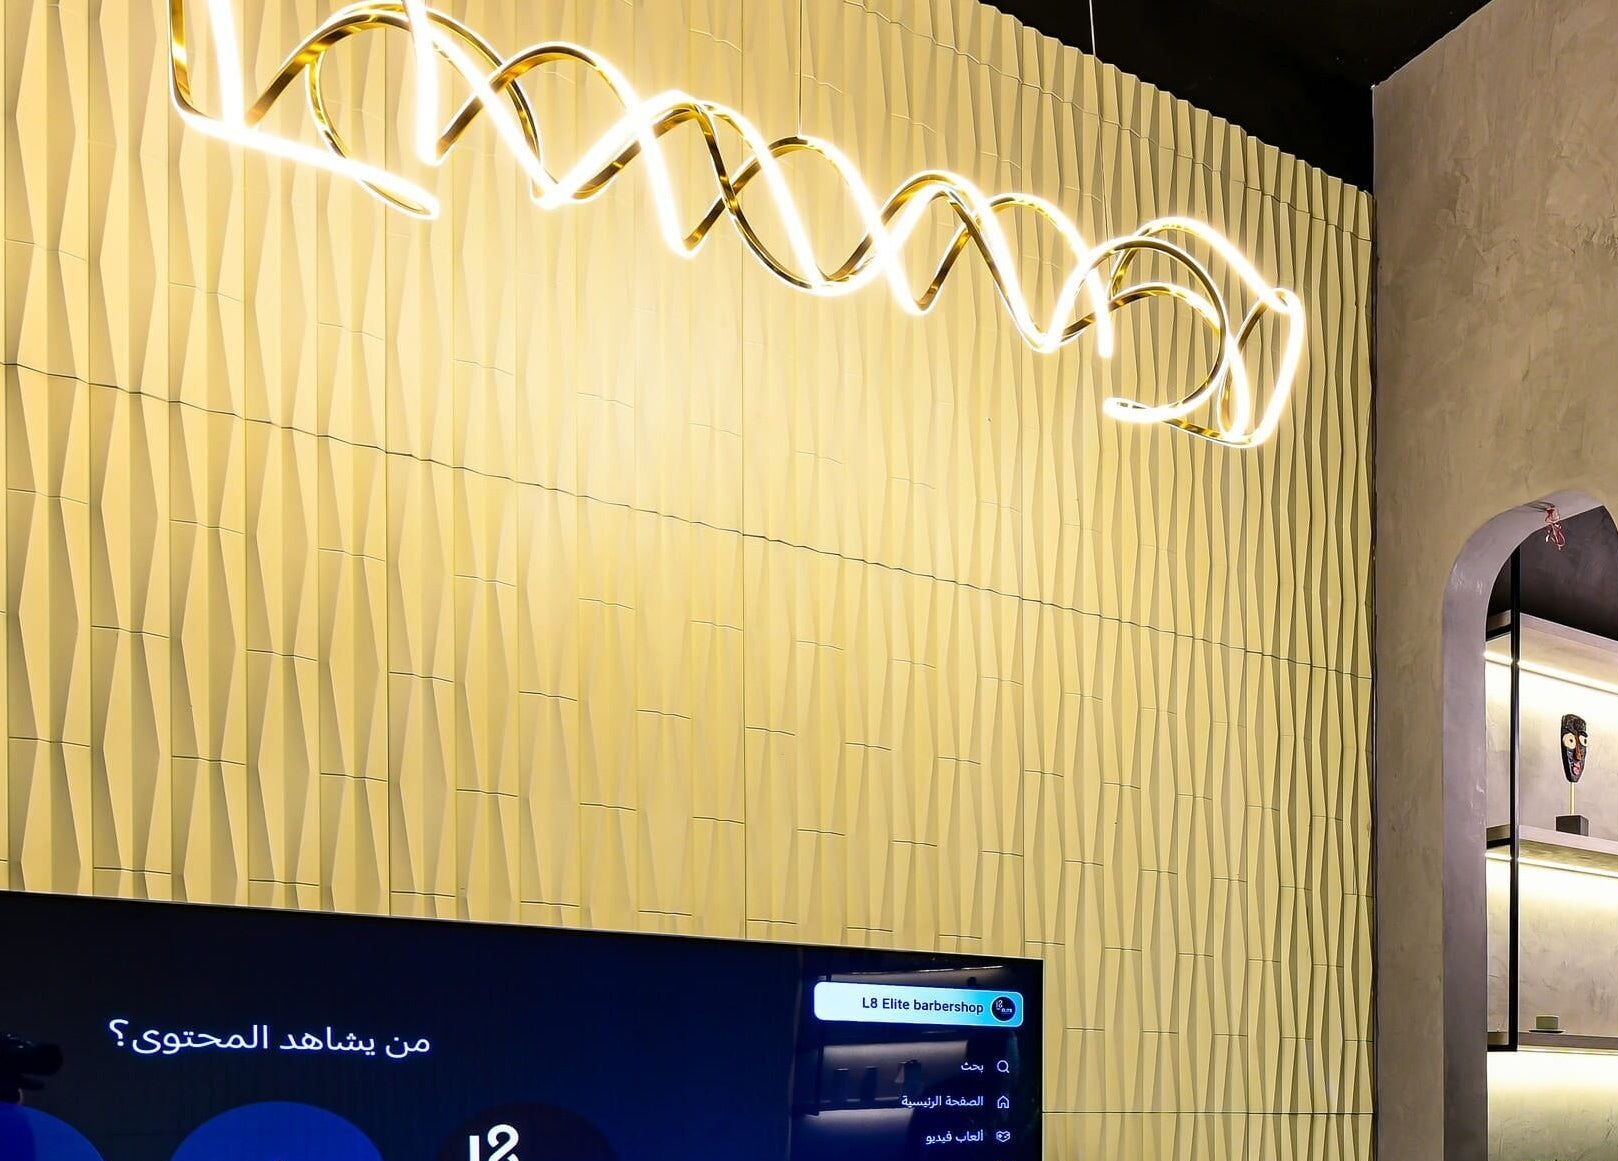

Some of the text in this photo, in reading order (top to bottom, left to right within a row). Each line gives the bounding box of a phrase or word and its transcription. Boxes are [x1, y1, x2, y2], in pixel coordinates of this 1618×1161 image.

[861, 996, 984, 1015] L8 Elite barbershop
[108, 1018, 431, 1059] من يشاهد المحتوى؟
[960, 1061, 984, 1073] بحث
[901, 1095, 984, 1109] الصفحة الرئيسية
[925, 1129, 984, 1145] ألعاب فيديو
